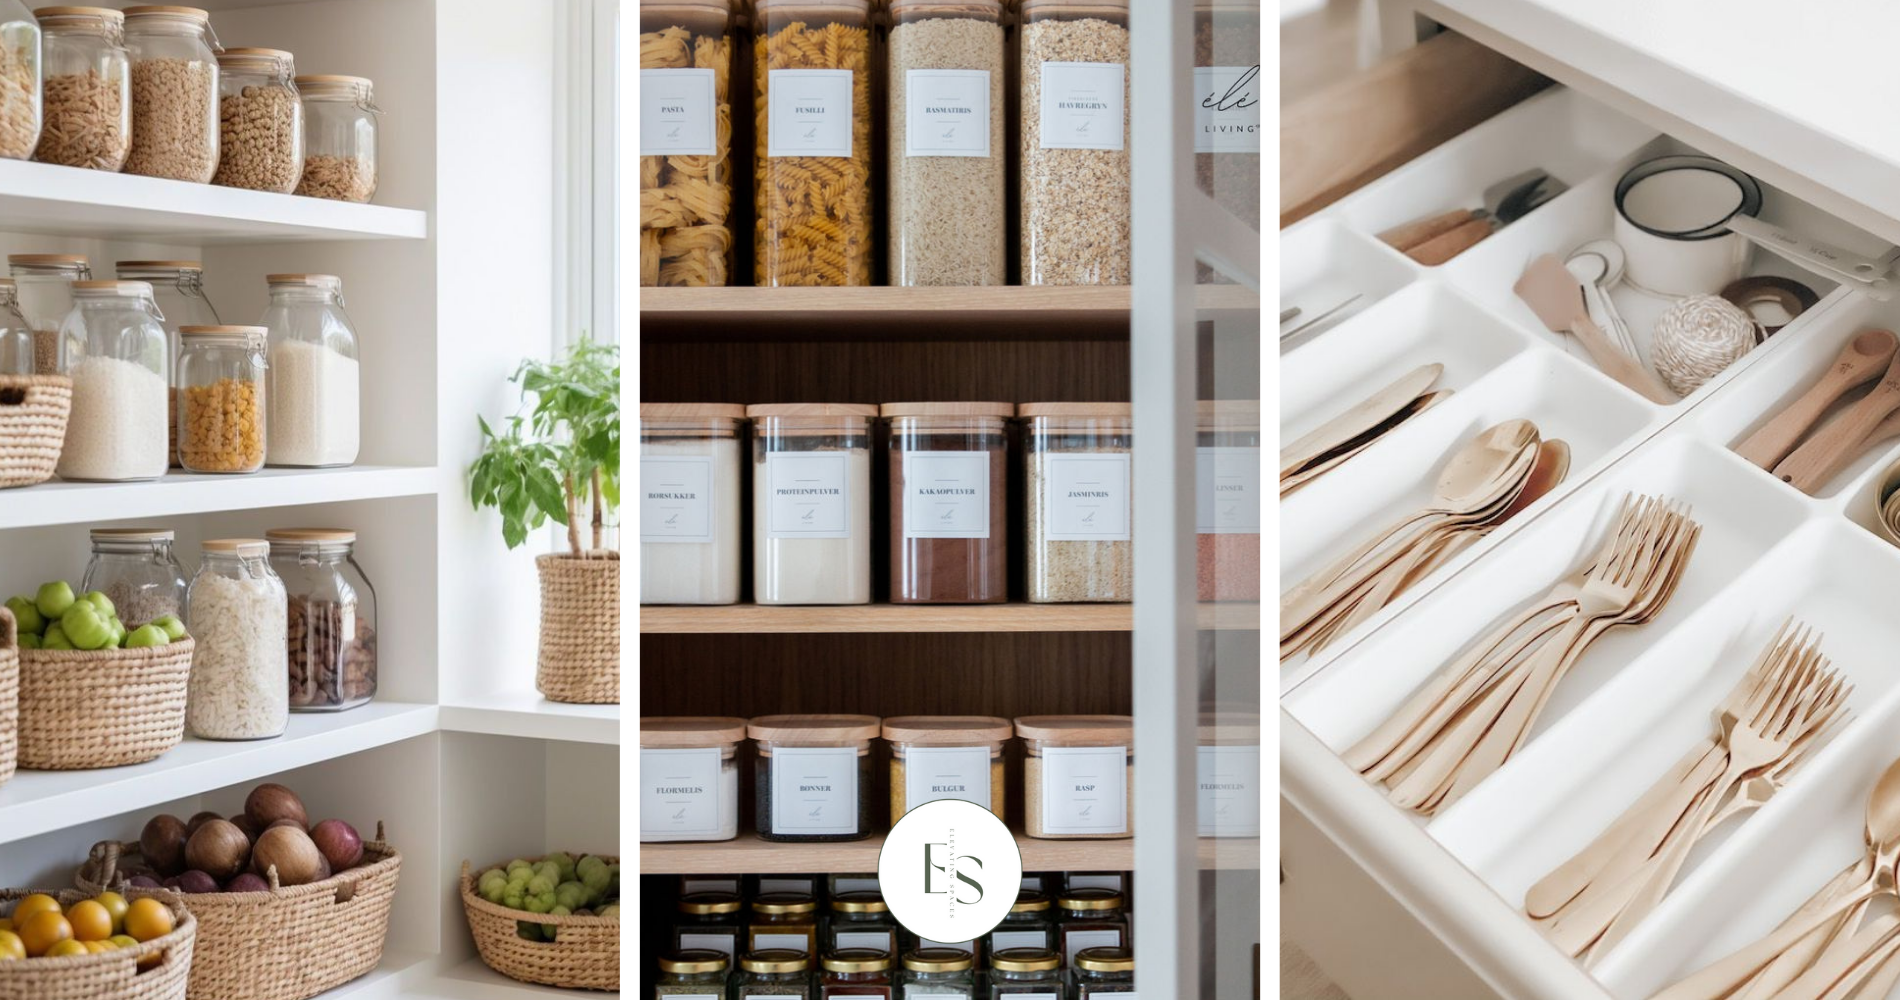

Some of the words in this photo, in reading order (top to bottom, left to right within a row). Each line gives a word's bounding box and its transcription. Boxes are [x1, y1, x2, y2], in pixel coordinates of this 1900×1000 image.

[1058, 101, 1109, 110] HAVREGRYN
[656, 786, 704, 794] FLORMELIS
[1075, 784, 1096, 792] RASP
